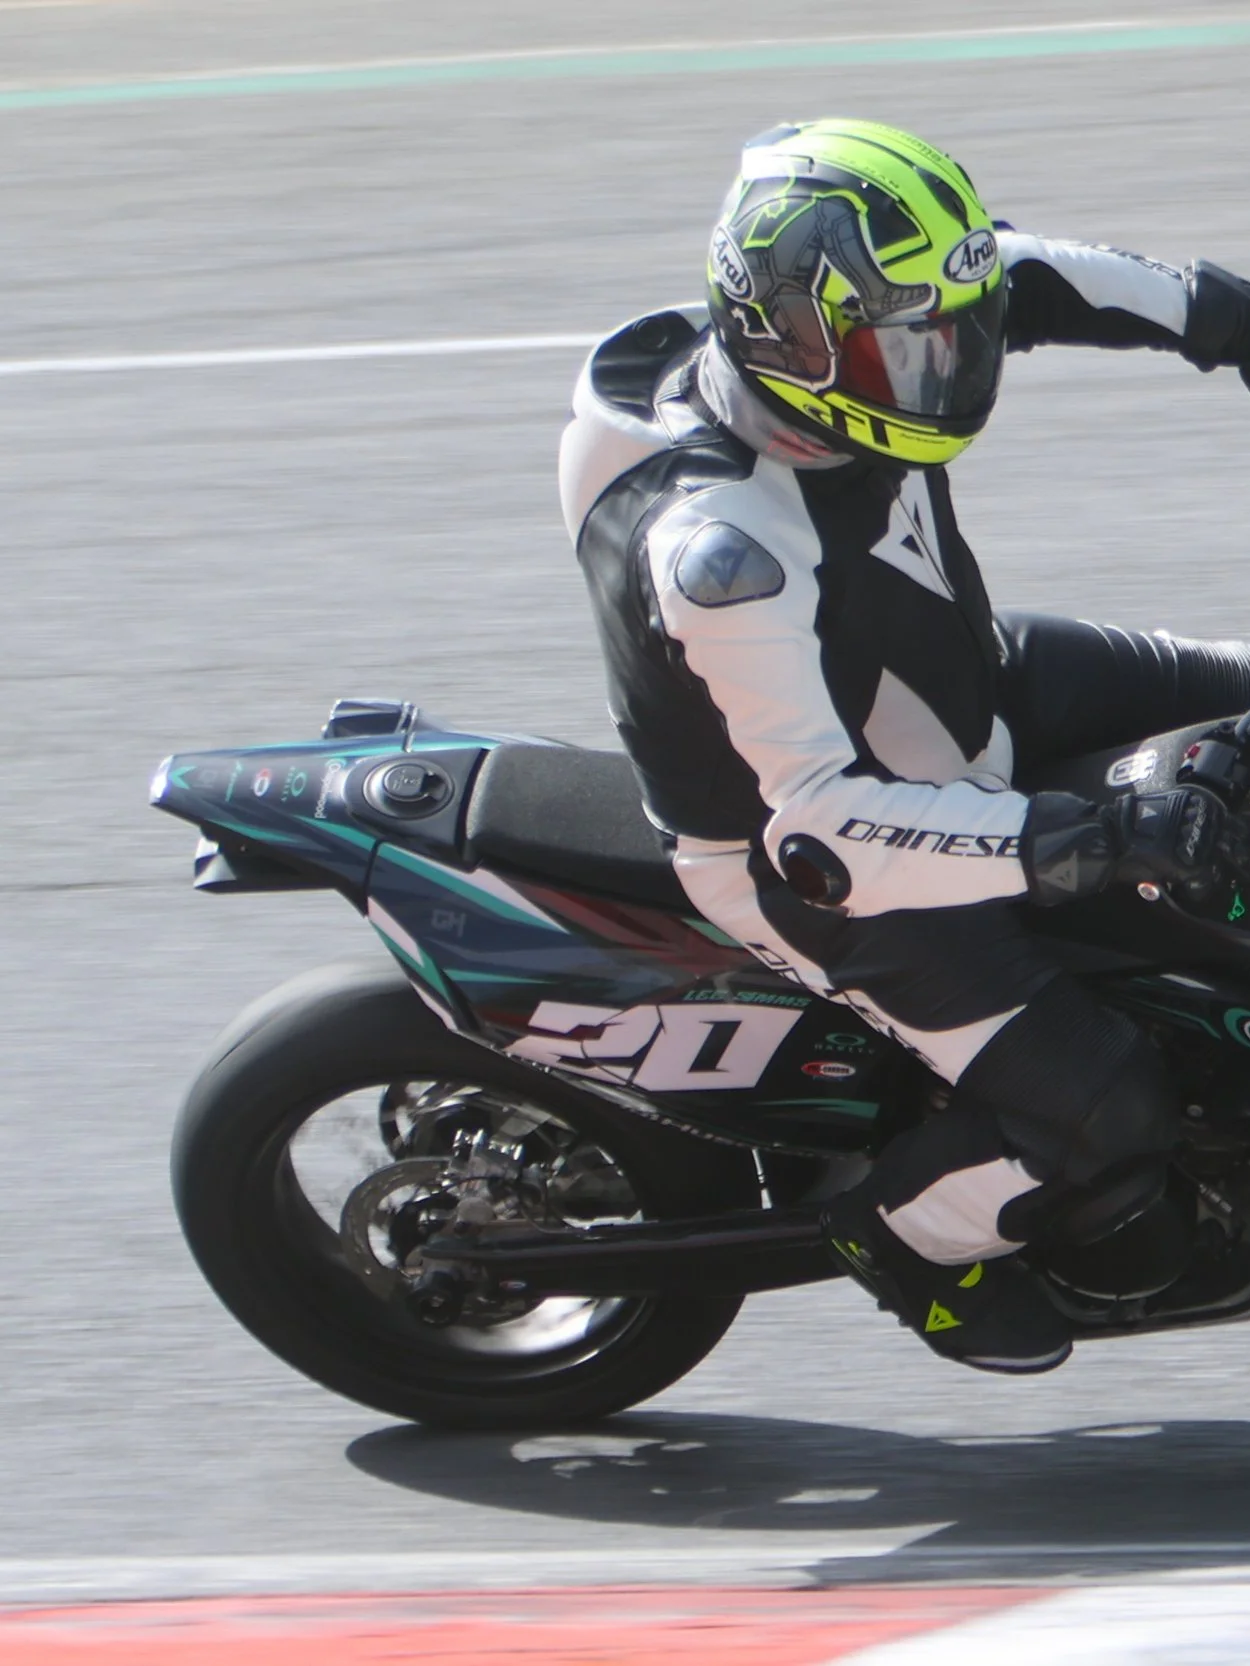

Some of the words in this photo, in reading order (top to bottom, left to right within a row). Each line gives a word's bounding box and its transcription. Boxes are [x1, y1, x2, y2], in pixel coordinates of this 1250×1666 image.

[714, 239, 748, 291] Arai
[951, 234, 995, 279] Arai
[836, 818, 1021, 858] DAINESE
[500, 1000, 804, 1092] 20
